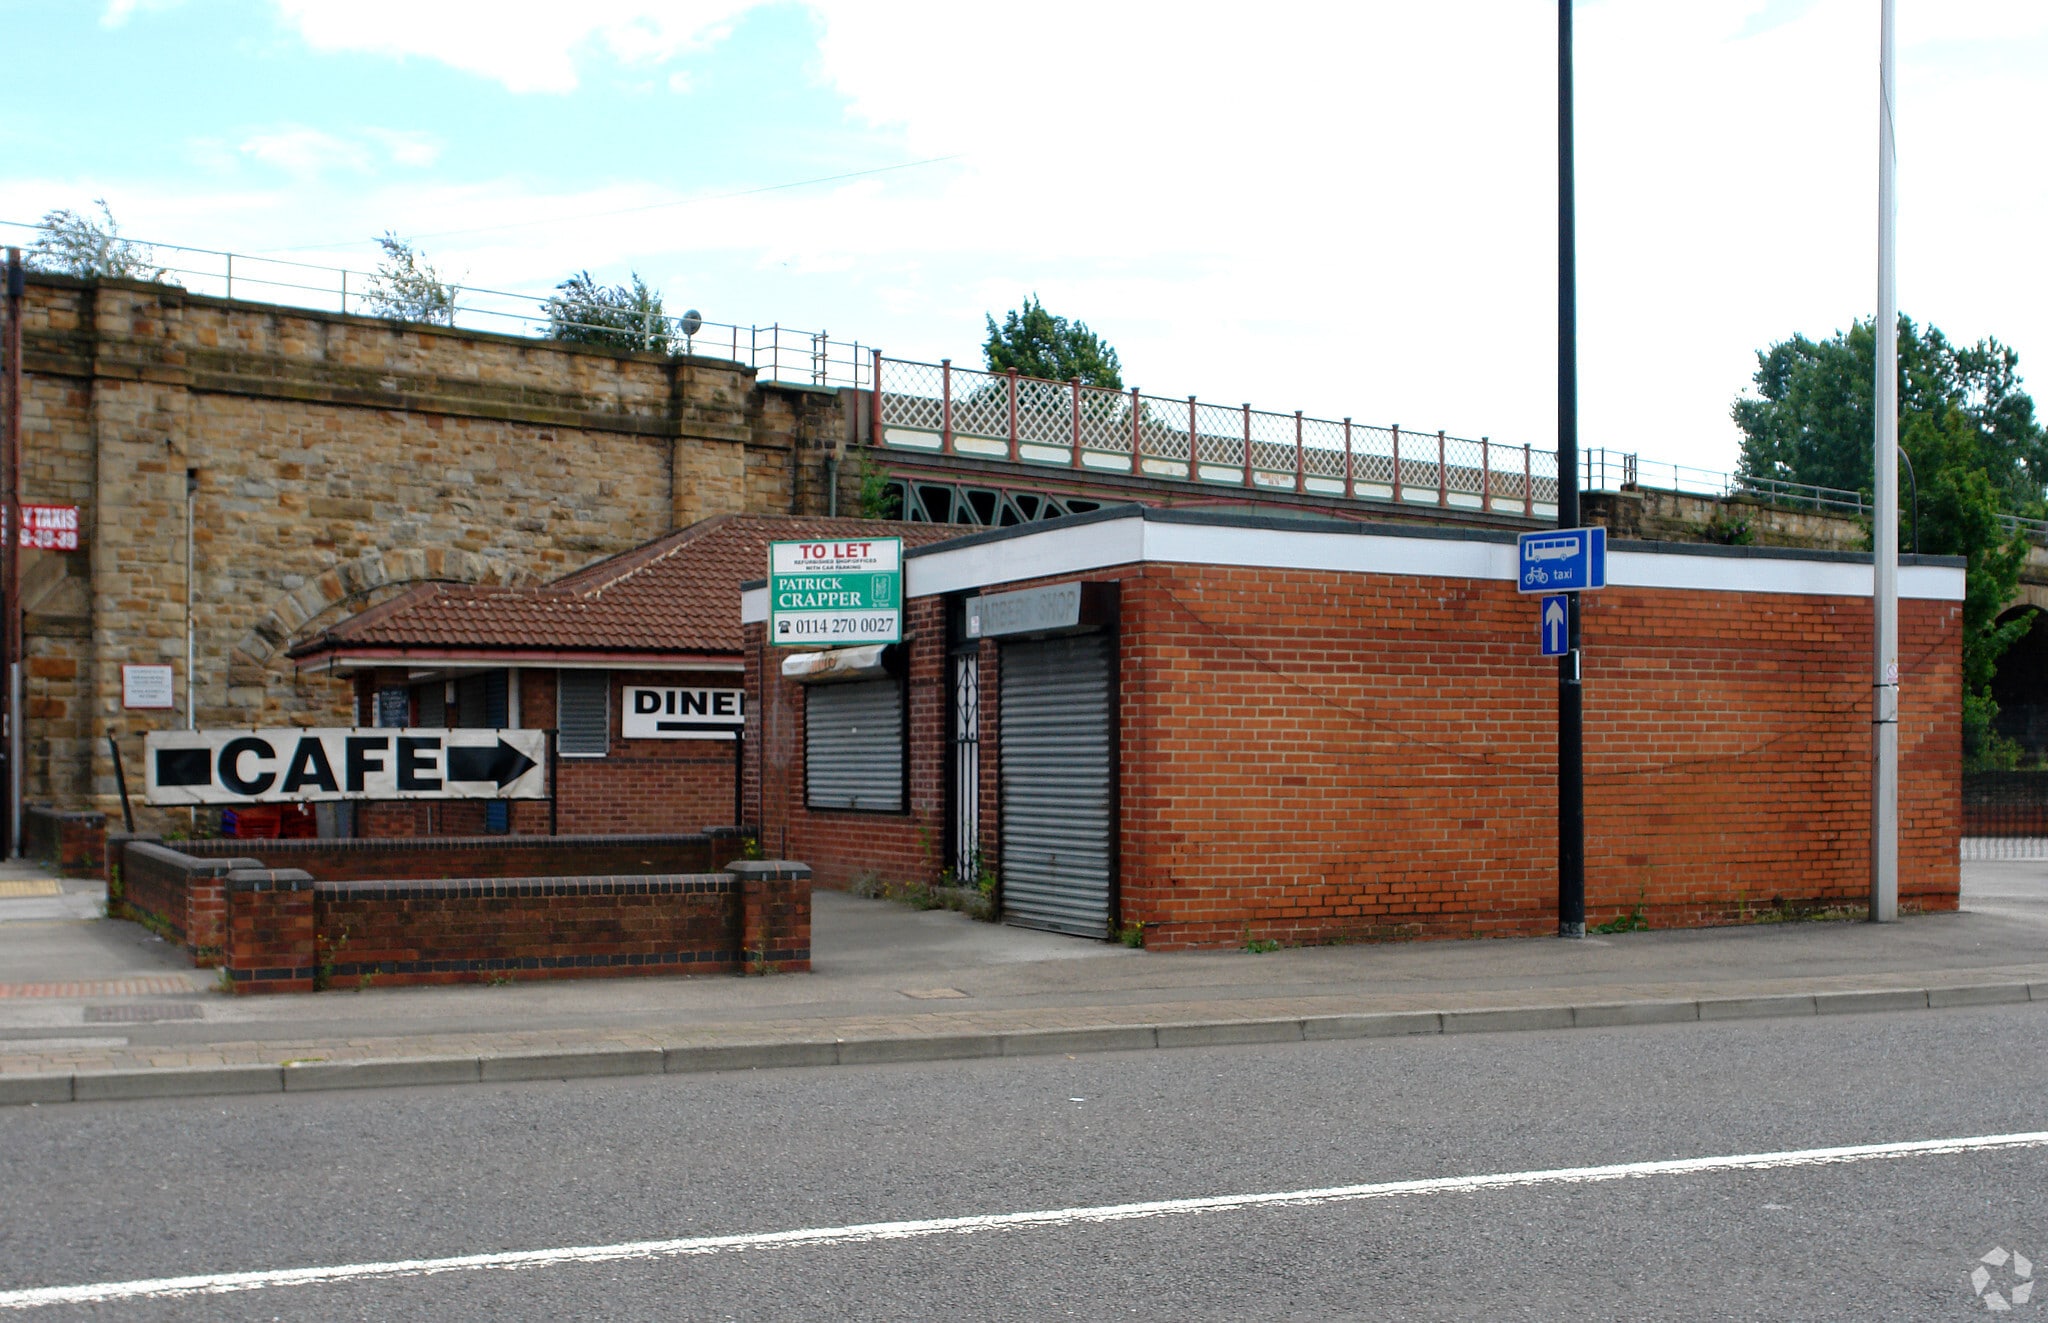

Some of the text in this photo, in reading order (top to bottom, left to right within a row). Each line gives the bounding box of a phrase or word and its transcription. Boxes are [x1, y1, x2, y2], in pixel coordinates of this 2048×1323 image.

[34, 507, 77, 529] TAXIS
[800, 543, 871, 559] TO LET
[1553, 568, 1573, 580] taxi
[779, 577, 842, 591] PATRICK
[779, 592, 862, 608] CRAPPER
[796, 617, 894, 634] 0114 270 0027
[634, 690, 744, 716] DINE
[217, 736, 443, 795] CAFE
